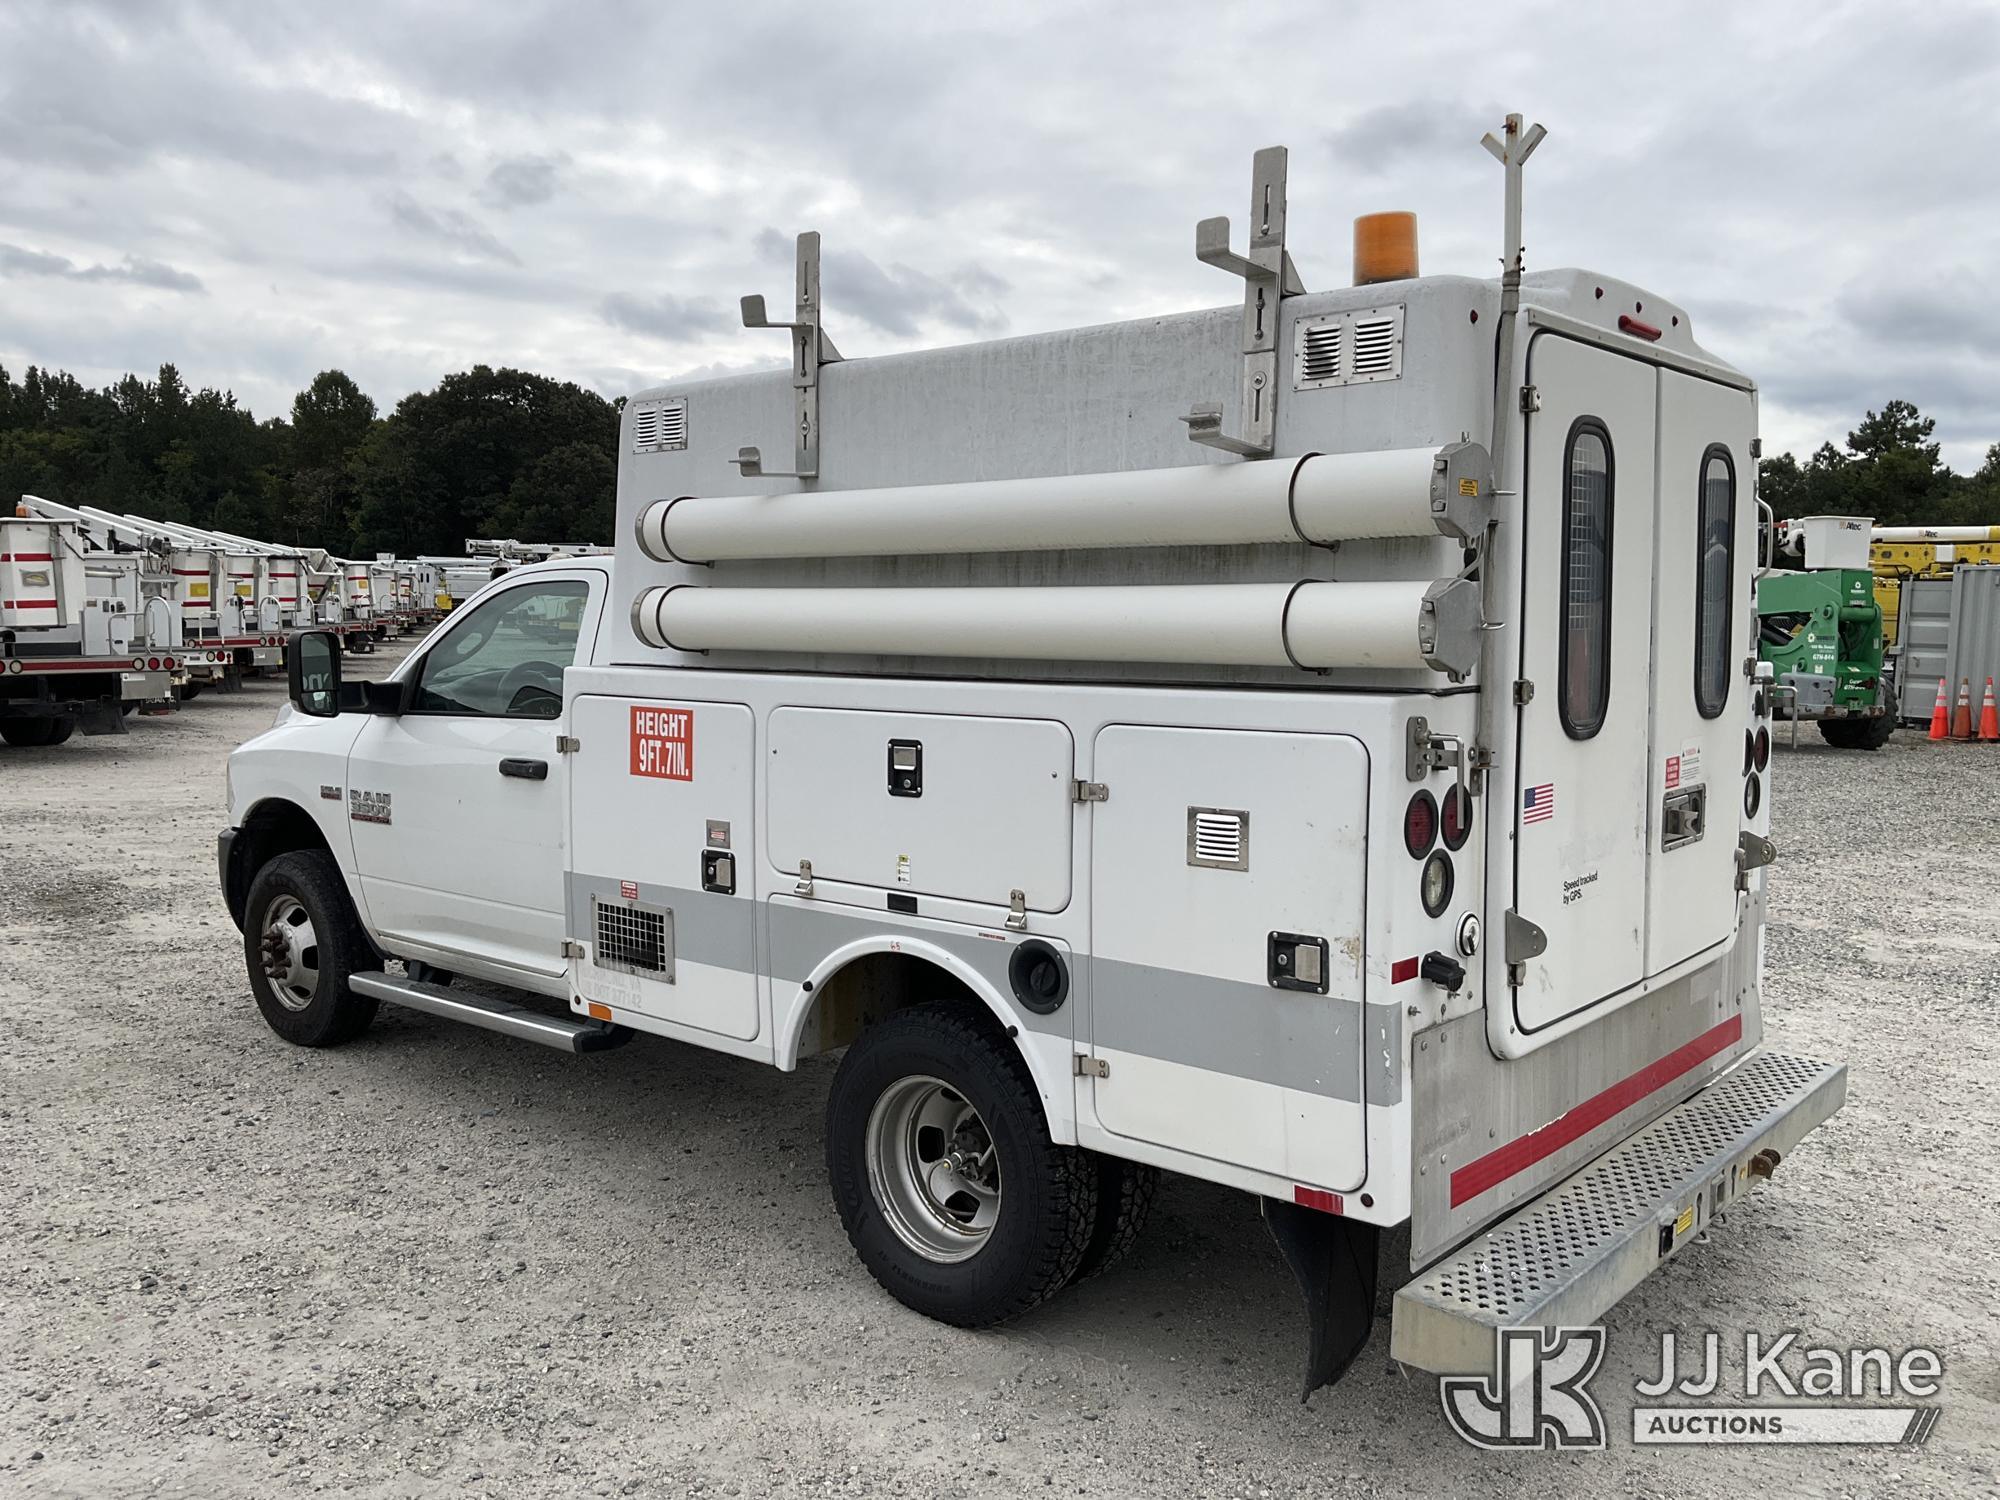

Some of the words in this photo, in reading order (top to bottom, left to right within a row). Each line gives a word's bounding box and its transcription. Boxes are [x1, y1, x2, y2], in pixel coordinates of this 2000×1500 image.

[636, 711, 688, 738] HEIGHT
[639, 738, 689, 777] 9FT.7IN.
[350, 789, 392, 806] RAM
[350, 801, 392, 817] 3500
[1563, 876, 1580, 892] Speed
[1580, 869, 1598, 885] tracked
[1563, 894, 1570, 905] by
